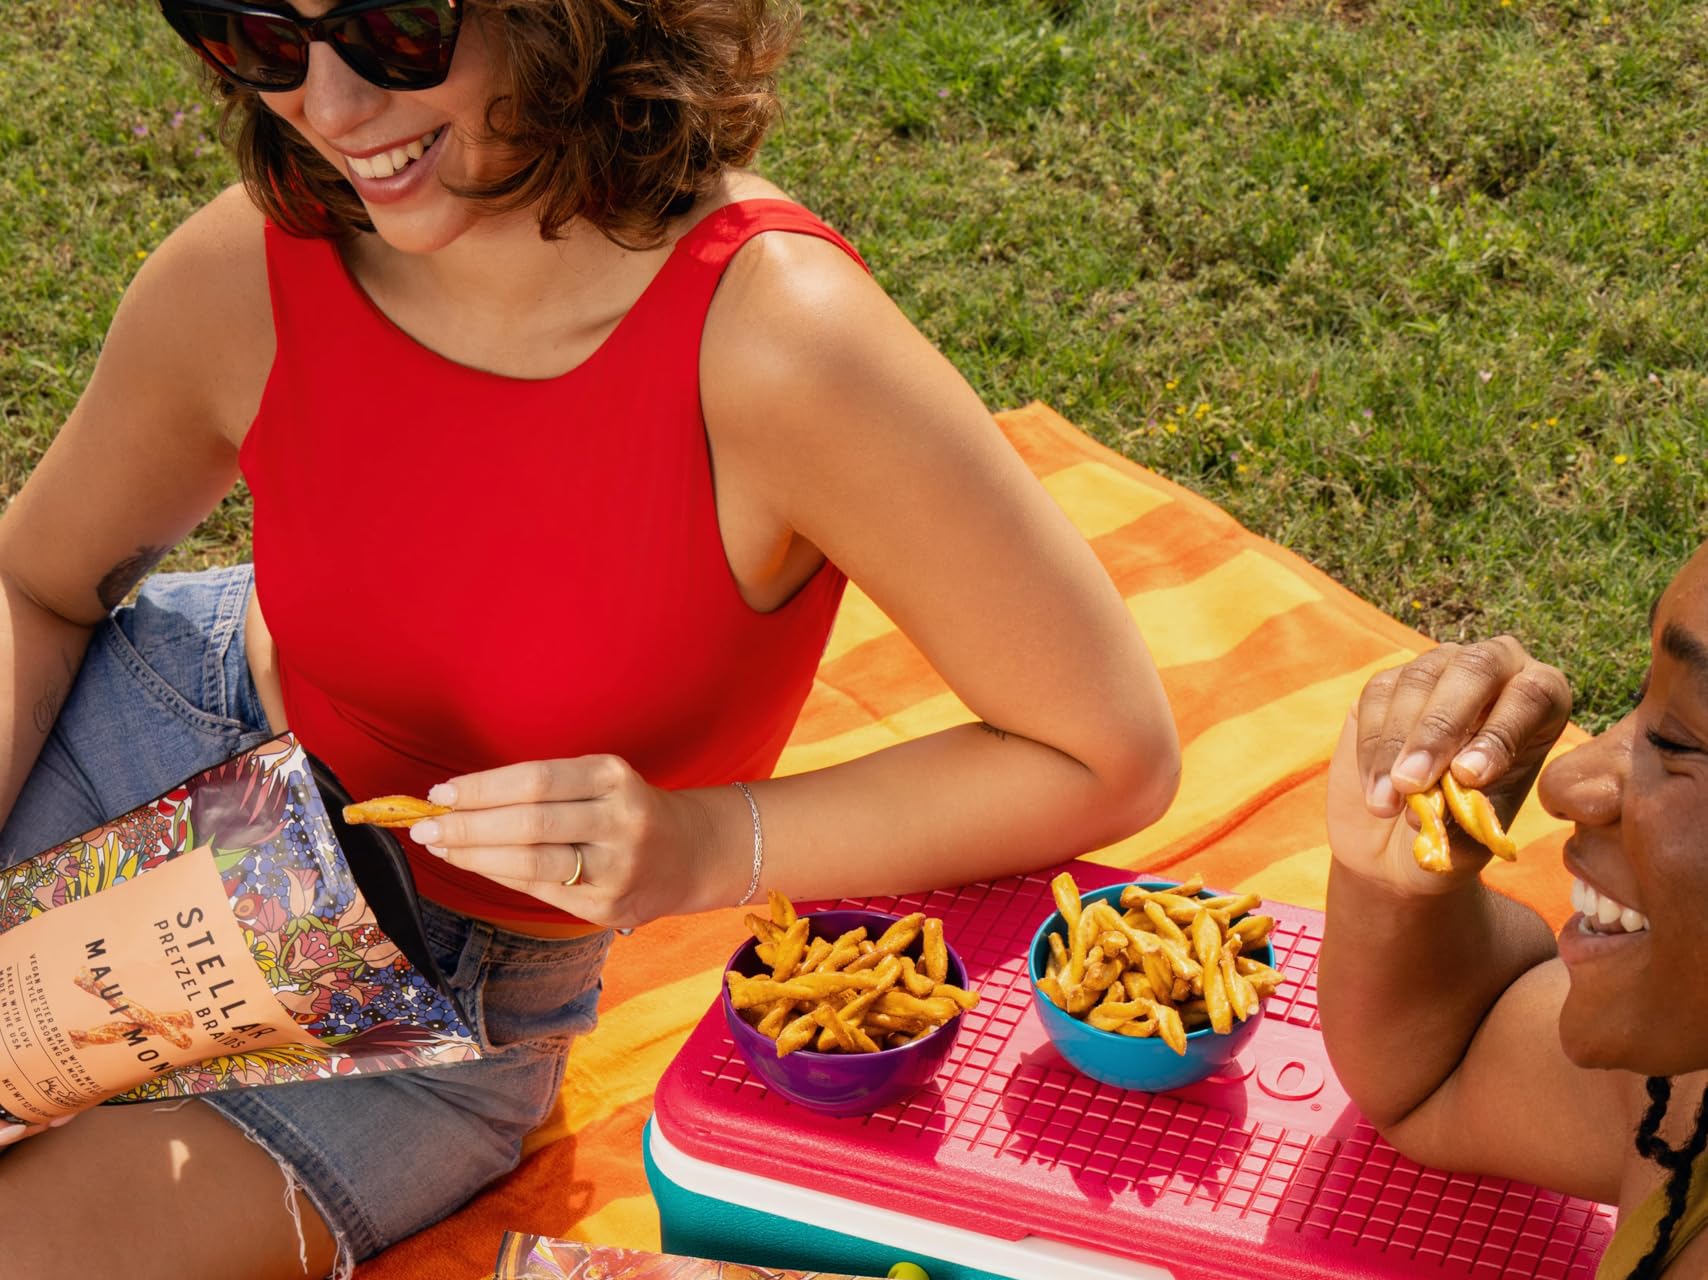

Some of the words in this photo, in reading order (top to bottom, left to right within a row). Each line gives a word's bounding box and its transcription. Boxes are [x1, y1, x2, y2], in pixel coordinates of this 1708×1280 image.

[6, 966, 15, 995] BAKED
[85, 938, 130, 1015] MAUI
[154, 919, 201, 1002] PRETZEL
[195, 1007, 247, 1049] BRAIDS
[176, 907, 277, 1039] STELLAR
[1, 998, 8, 1008] IN
[10, 998, 22, 1023] WITH
[25, 975, 38, 1003] STYLE
[34, 1007, 62, 1057] SEASONING
[29, 953, 41, 984] VEGAN
[36, 988, 54, 1023] BUTTER
[51, 1026, 70, 1053] BRAID
[68, 1054, 86, 1074] WITH
[3, 1011, 13, 1028] THE
[9, 1032, 21, 1050] USA
[18, 1026, 33, 1048] LOVE
[2, 1078, 17, 1091] NET
